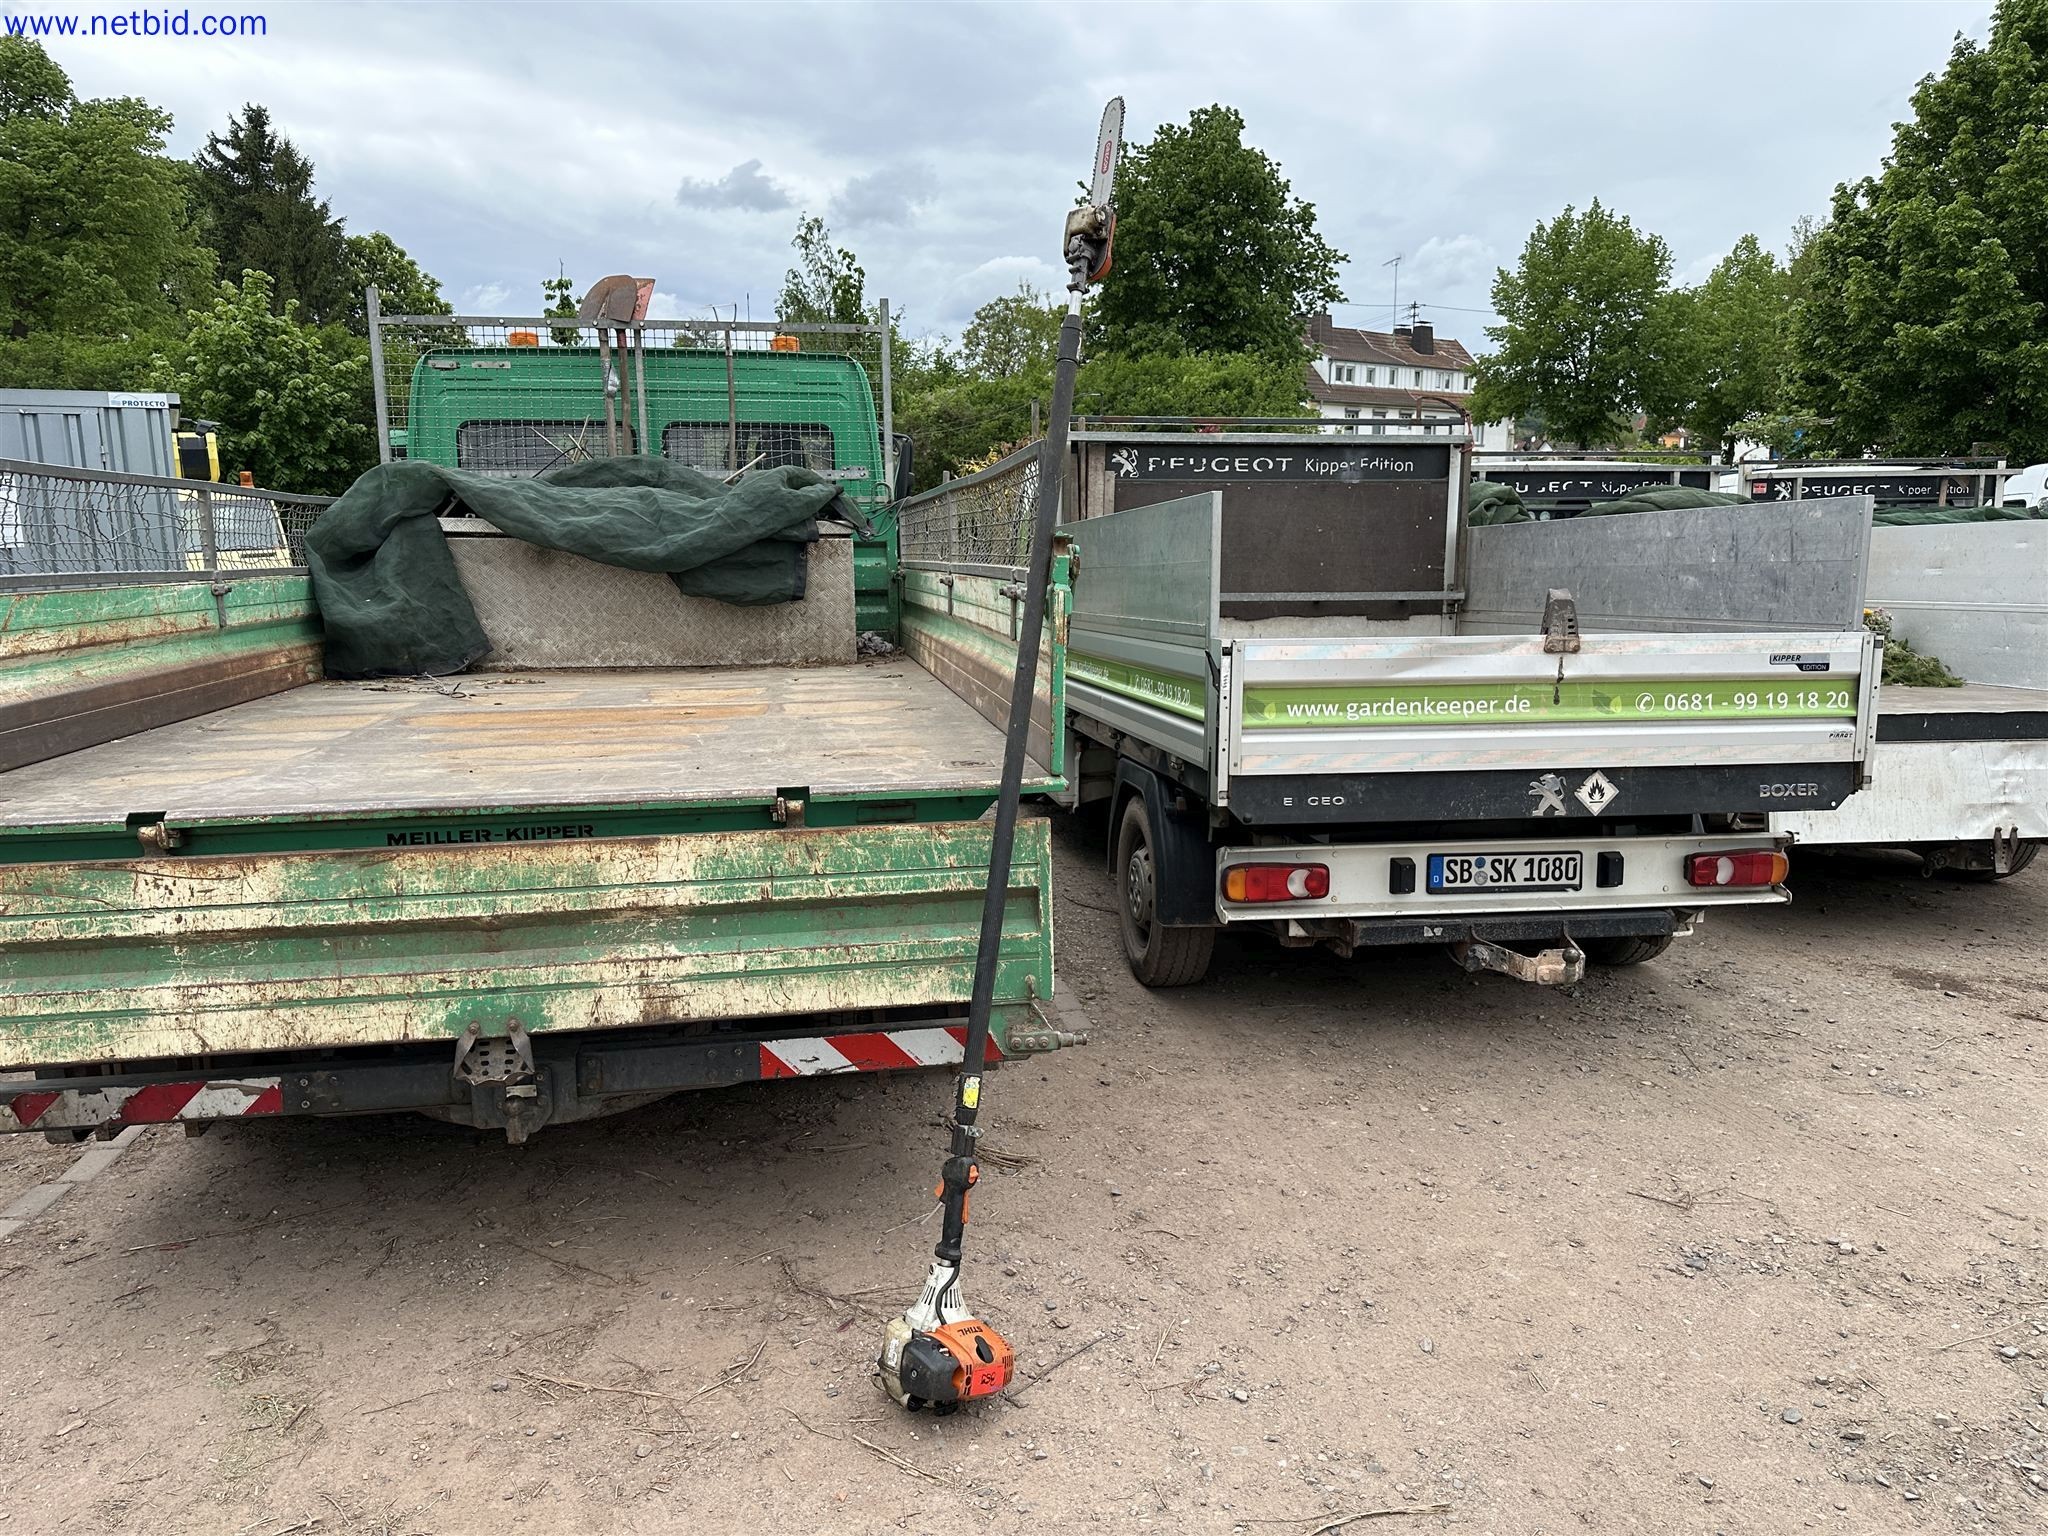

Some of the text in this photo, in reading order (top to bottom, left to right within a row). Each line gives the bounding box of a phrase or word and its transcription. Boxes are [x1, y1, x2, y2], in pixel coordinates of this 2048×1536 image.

[1772, 654, 1801, 662] KIPPER
[1287, 695, 1531, 721] www.gardenkeeper.de
[1664, 693, 1713, 711] 0681
[1733, 693, 1758, 710] 99
[1766, 692, 1788, 709] 19
[1796, 691, 1819, 709] 18
[1826, 691, 1849, 709] 20
[1759, 783, 1819, 798] BOXER
[387, 824, 594, 847] MEILLER-KIPPER
[1445, 856, 1578, 884] SB SK 1080
[957, 1326, 983, 1336] STIHL
